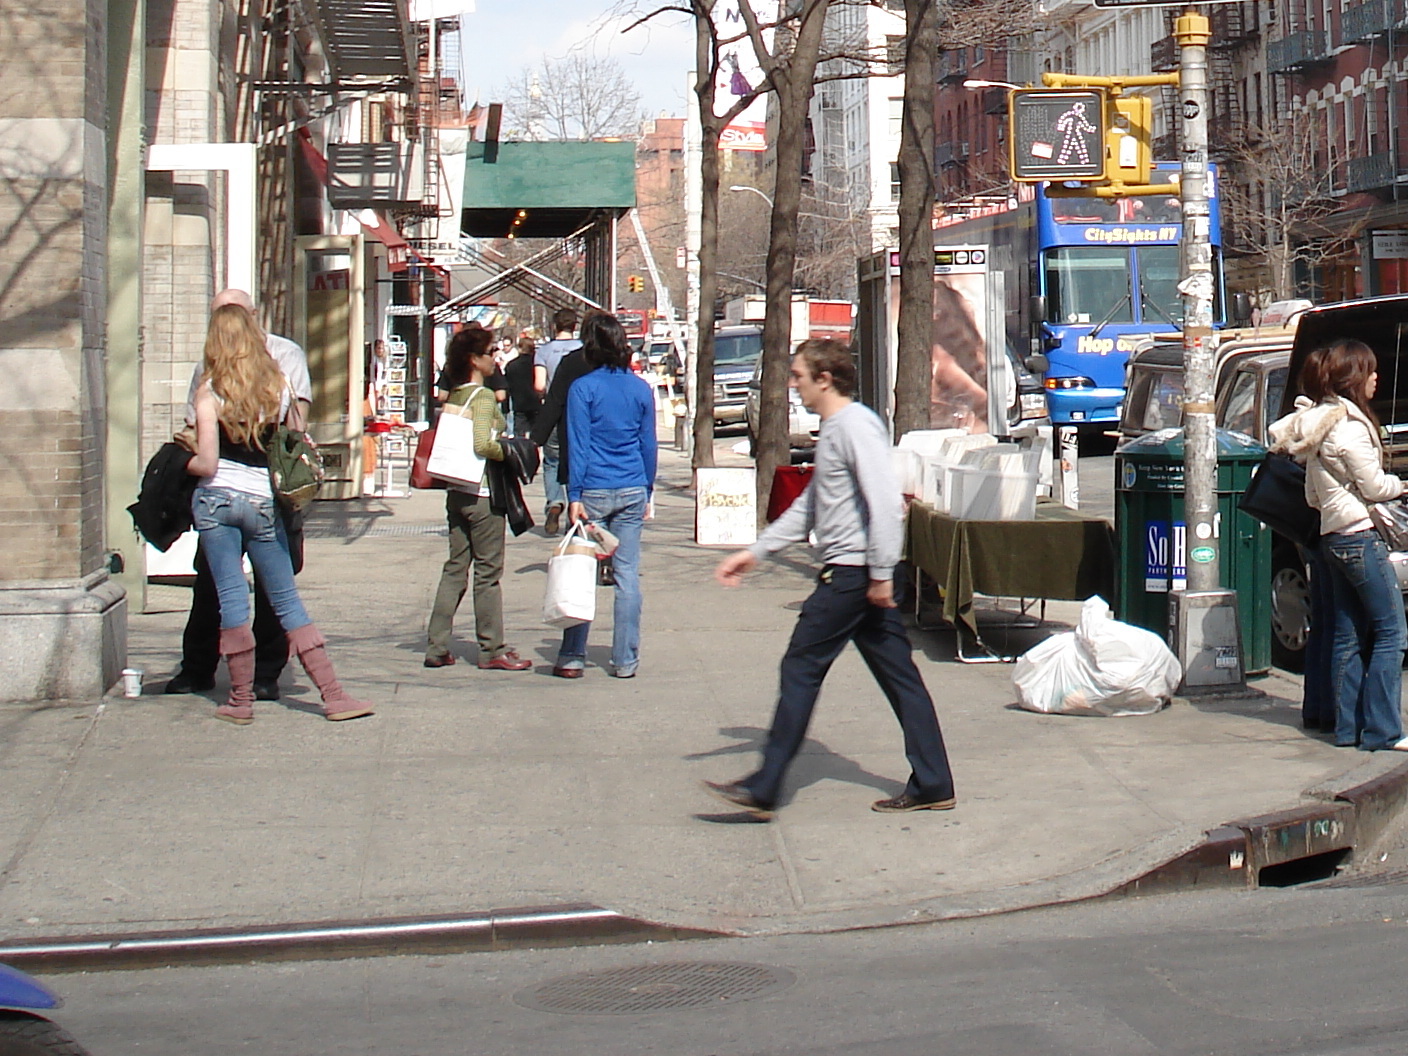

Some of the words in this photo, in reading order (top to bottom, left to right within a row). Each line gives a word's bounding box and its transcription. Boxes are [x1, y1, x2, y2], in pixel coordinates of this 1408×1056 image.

[1084, 227, 1157, 244] CitySights
[1158, 227, 1177, 241] NY
[1078, 335, 1113, 355] Hop
[1117, 339, 1132, 352] o
